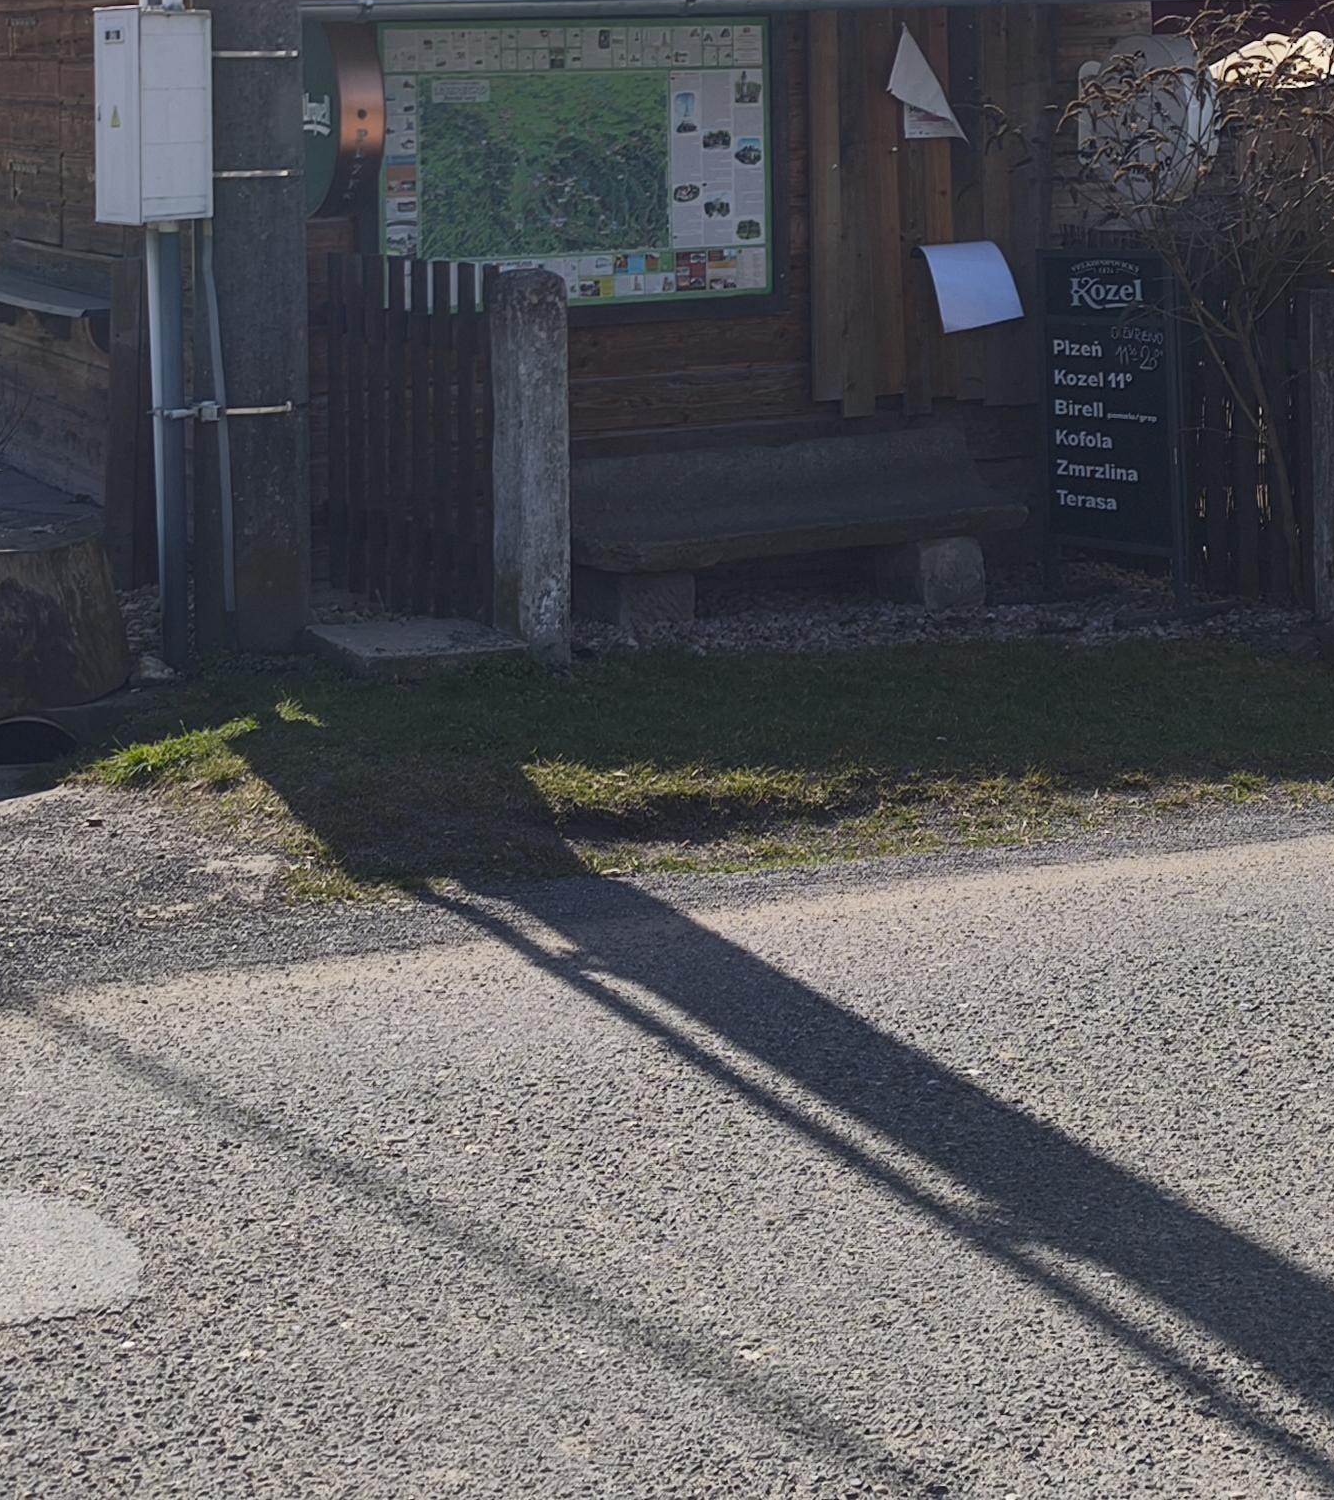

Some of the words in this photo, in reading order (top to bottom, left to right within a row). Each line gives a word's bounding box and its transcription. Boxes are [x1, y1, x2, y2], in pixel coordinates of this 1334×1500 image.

[1069, 276, 1145, 310] Kozel
[1052, 339, 1103, 358] Plzeň
[1053, 368, 1105, 388] Kozel
[1054, 399, 1104, 419] Birell
[1055, 428, 1114, 450] Kofola
[1056, 458, 1139, 482] Zmrzlina
[1055, 489, 1119, 511] Terasa
